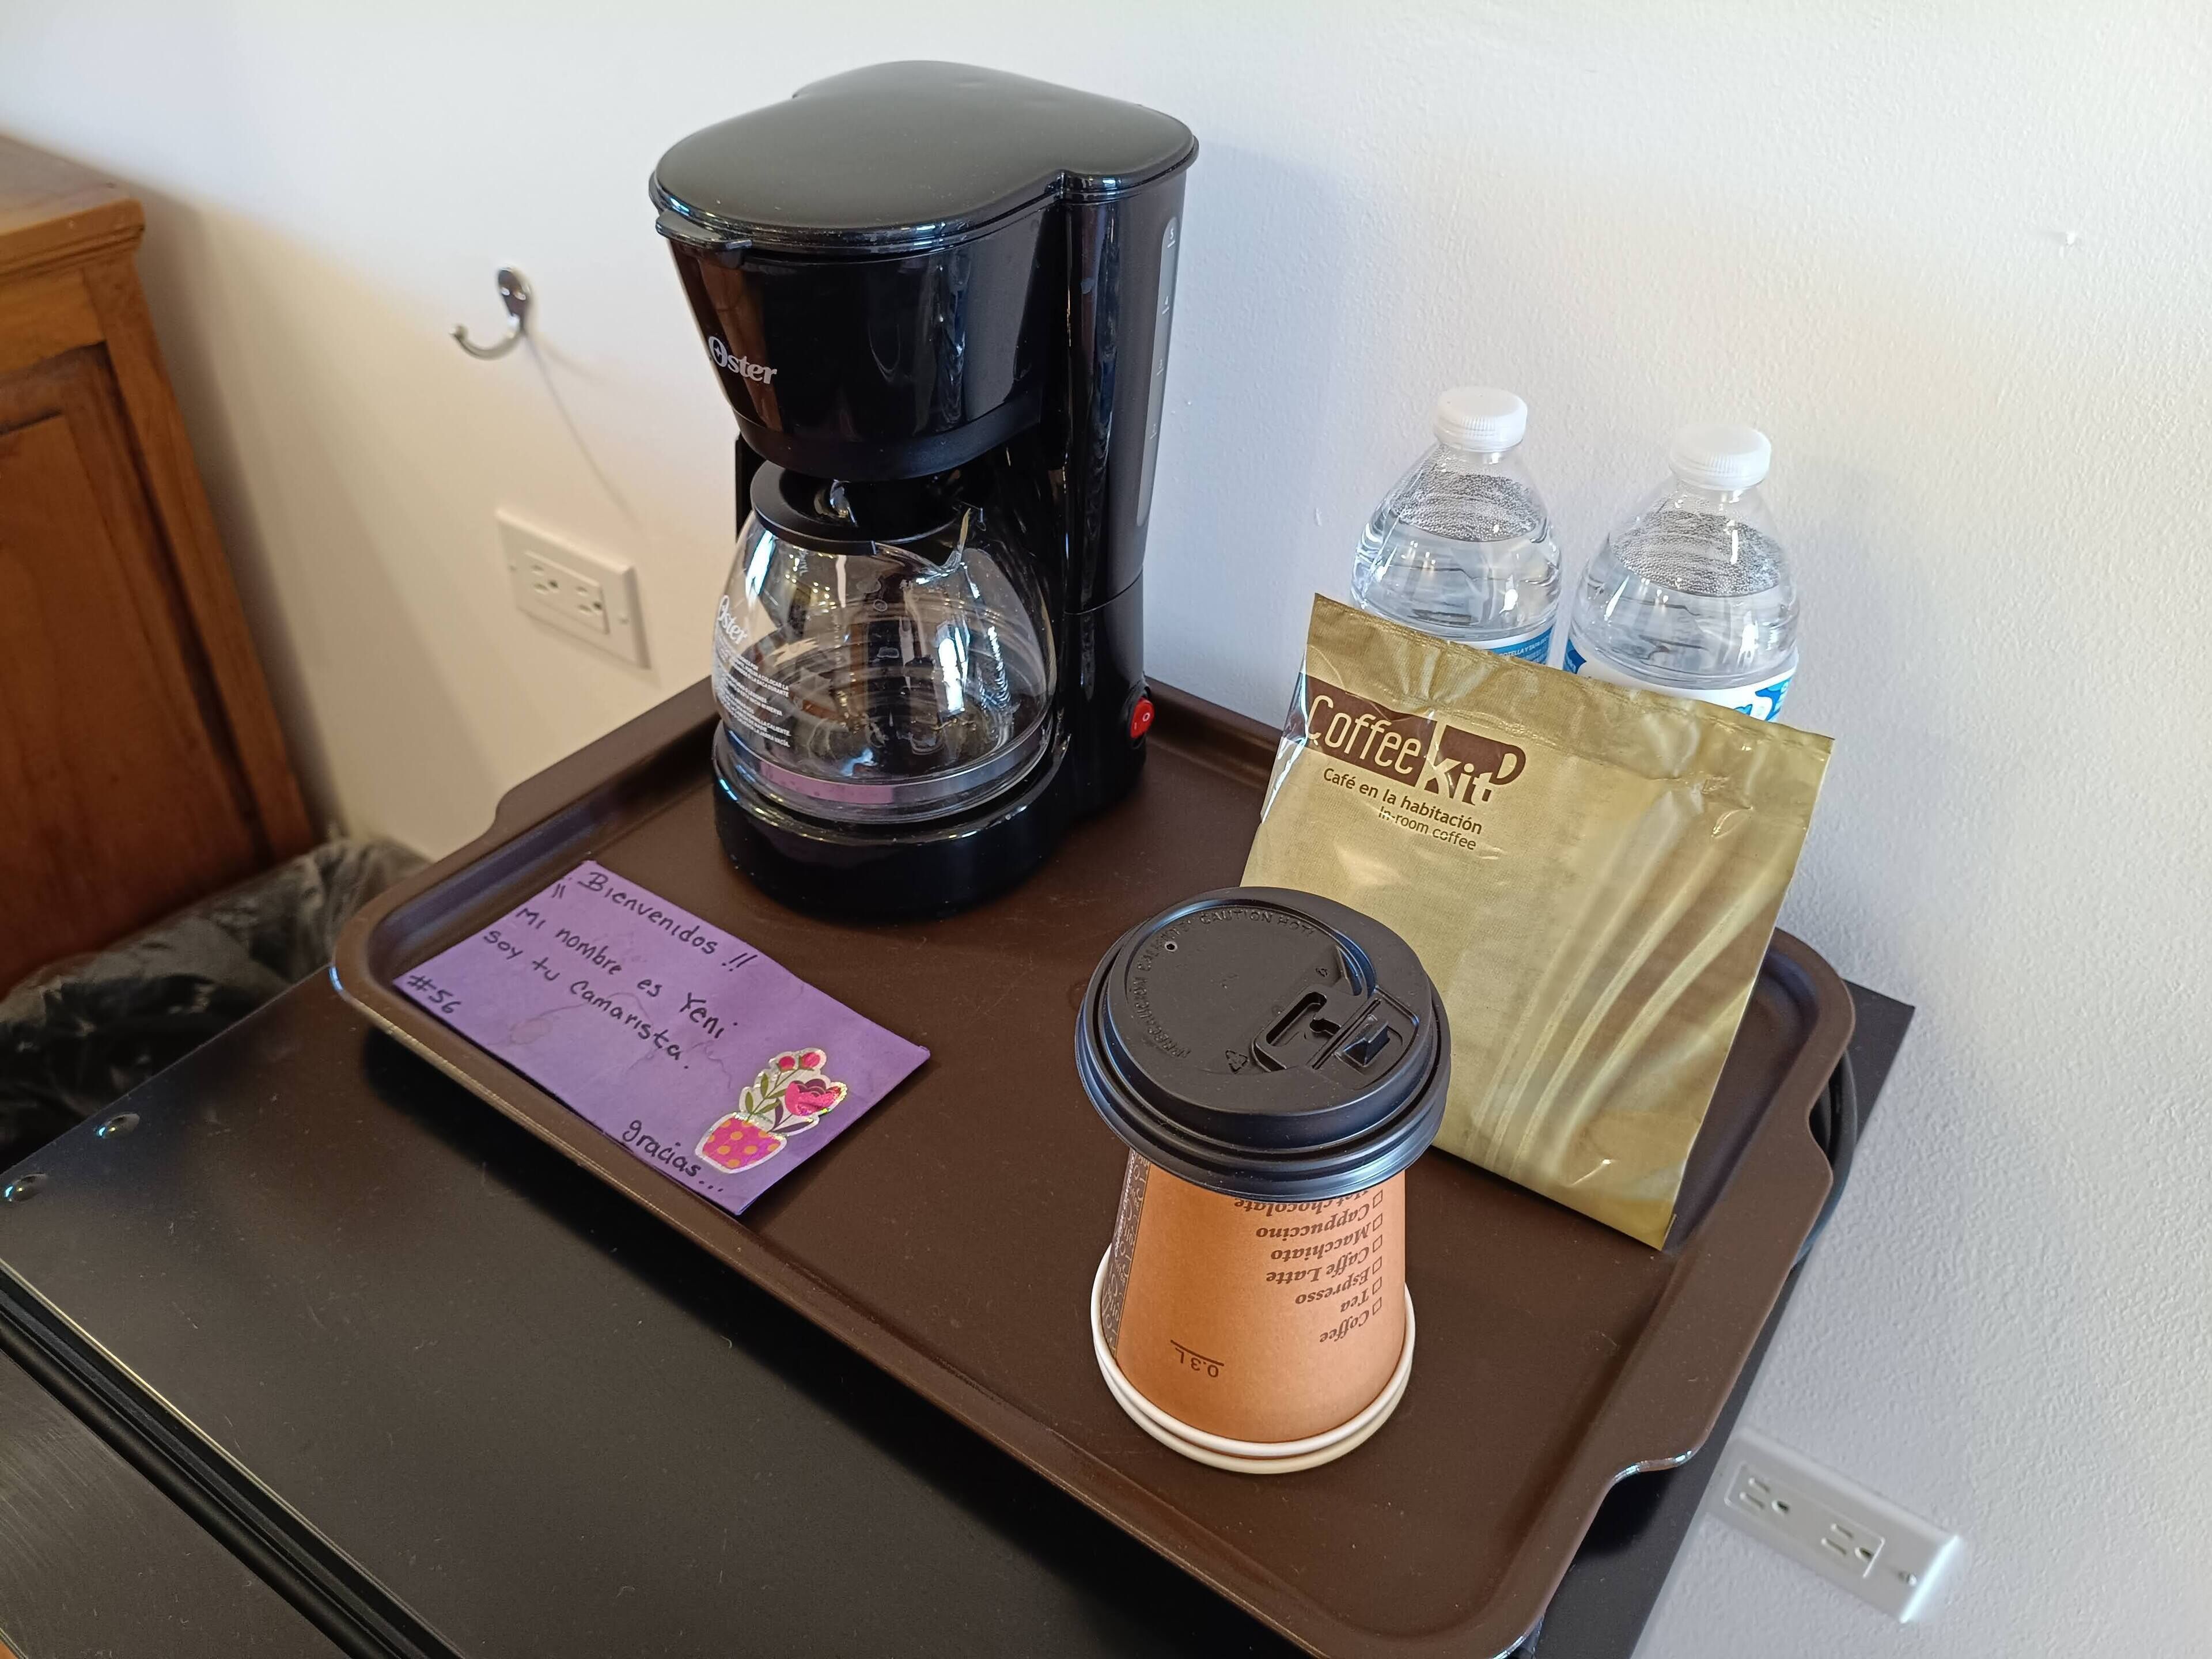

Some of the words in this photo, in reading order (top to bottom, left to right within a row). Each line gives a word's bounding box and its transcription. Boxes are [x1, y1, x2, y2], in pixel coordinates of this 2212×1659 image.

[708, 336, 778, 385] Oster
[718, 595, 748, 645] Oster
[1306, 695, 1421, 774] Coffee
[1323, 767, 1356, 791] Café
[1359, 781, 1378, 799] en
[1382, 789, 1397, 805] la
[1400, 796, 1483, 835] habitación
[1432, 828, 1476, 850] coffee
[532, 957, 560, 980] tu
[555, 928, 622, 975] nombre
[637, 979, 662, 998] es
[407, 975, 461, 1015] #56
[1256, 1203, 1370, 1238] Cappuccino
[1270, 1223, 1372, 1260] Macchiato
[1325, 1246, 1369, 1272] Caffe
[1266, 1267, 1320, 1285] Latte
[1294, 1266, 1370, 1305] Espresso
[1340, 1289, 1369, 1313] Tea
[1319, 1309, 1370, 1344] Coffee
[1175, 1346, 1185, 1365] L
[1191, 1357, 1219, 1378] 0.3
